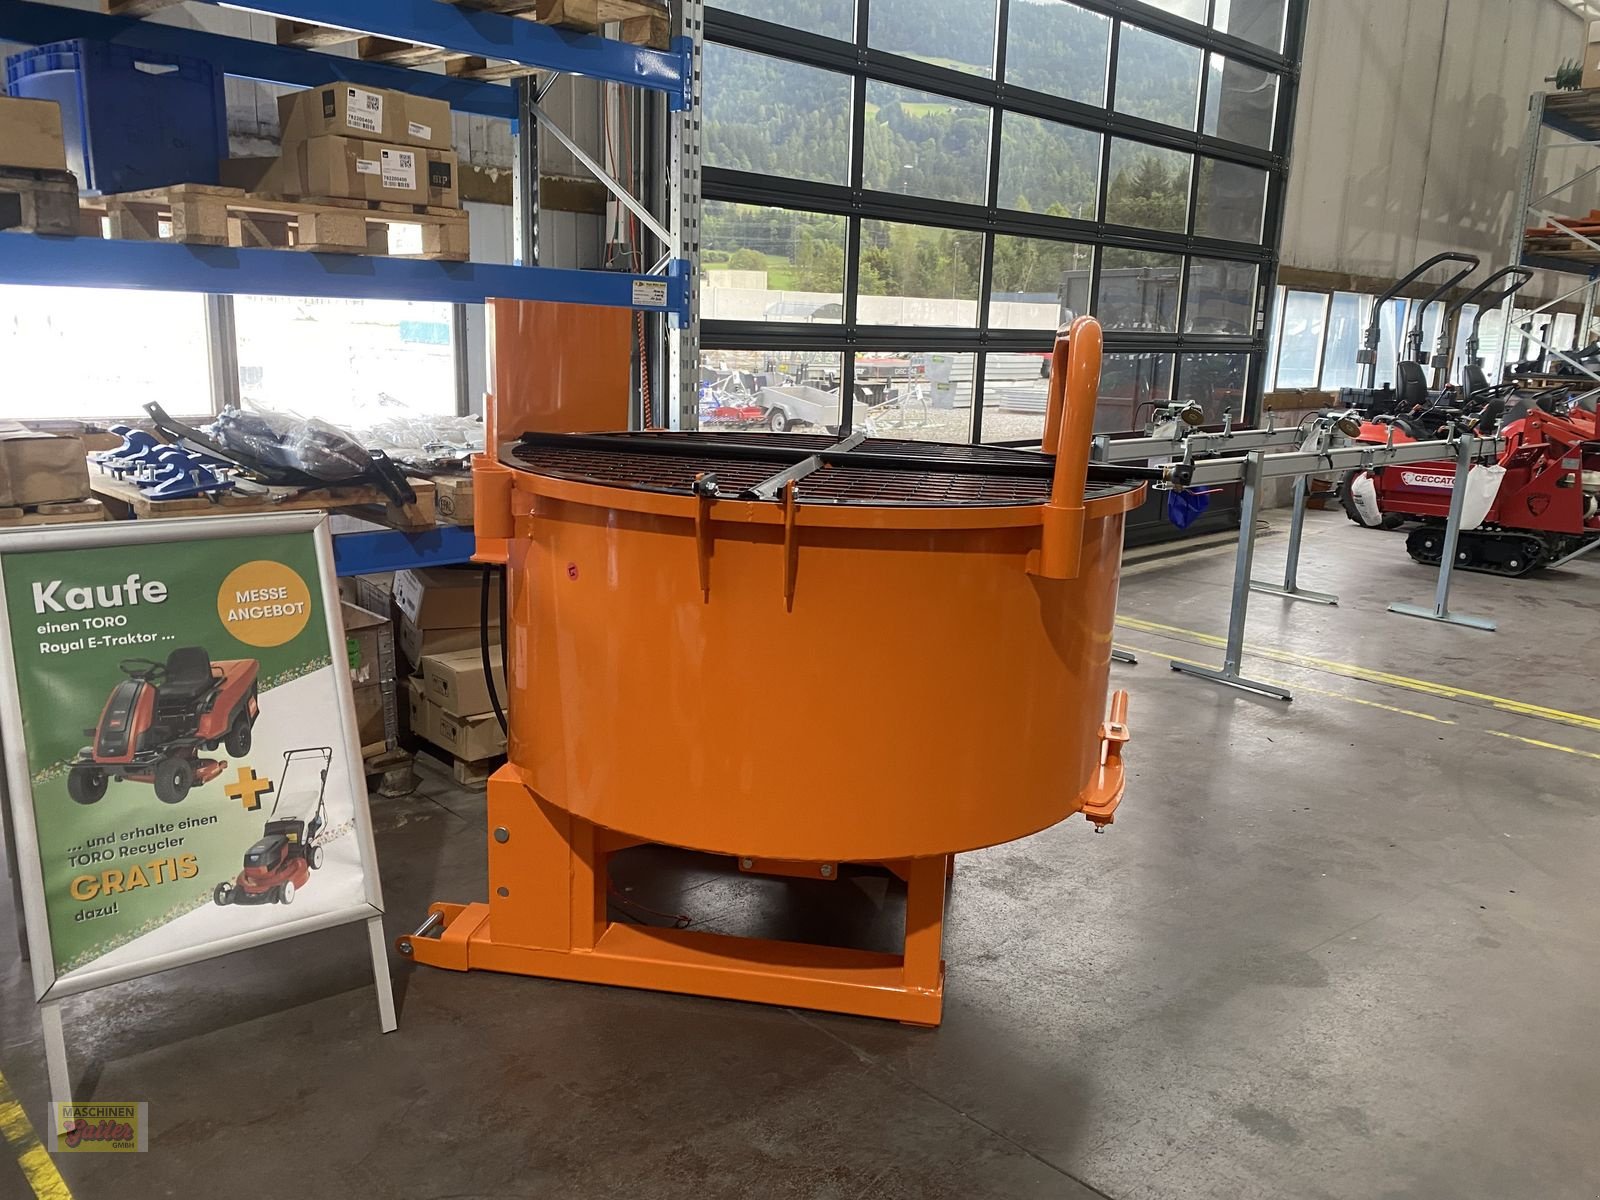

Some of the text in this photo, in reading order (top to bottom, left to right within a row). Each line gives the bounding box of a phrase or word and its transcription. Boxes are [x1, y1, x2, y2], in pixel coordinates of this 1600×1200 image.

[32, 573, 168, 614] Kaufe
[235, 586, 288, 604] MESSE
[227, 601, 304, 622] ANGEBOT
[37, 615, 127, 635] einen TORO
[39, 638, 84, 654] Royal
[88, 632, 158, 649] E-Traktor
[86, 832, 116, 849] und
[120, 823, 175, 841] erhalte
[178, 815, 218, 830] einen
[68, 836, 185, 868] TORO Recycler
[70, 852, 200, 902] GRATIS
[74, 901, 119, 923] dazu!
